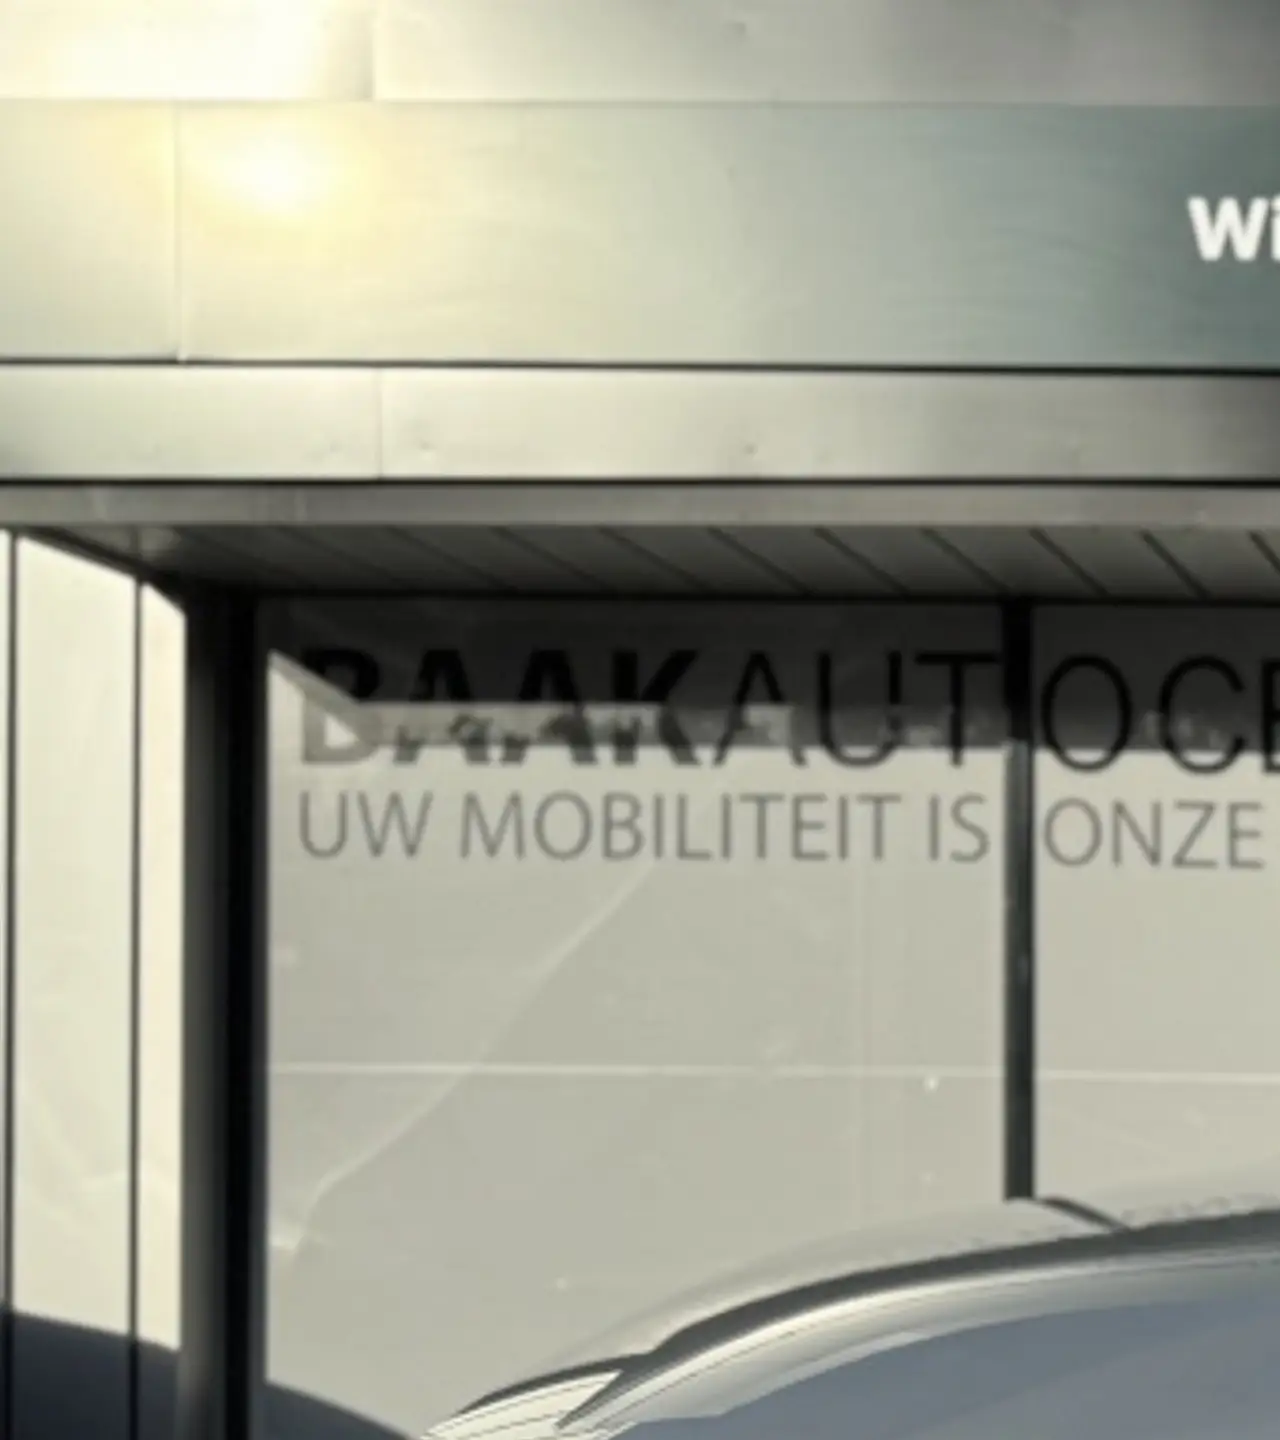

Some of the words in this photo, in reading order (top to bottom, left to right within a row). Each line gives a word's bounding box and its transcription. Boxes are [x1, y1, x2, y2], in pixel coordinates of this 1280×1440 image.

[298, 791, 434, 859] UW
[459, 791, 901, 863] MOBILITEIT
[929, 792, 990, 864] IS
[1043, 798, 1263, 871] ONZE
